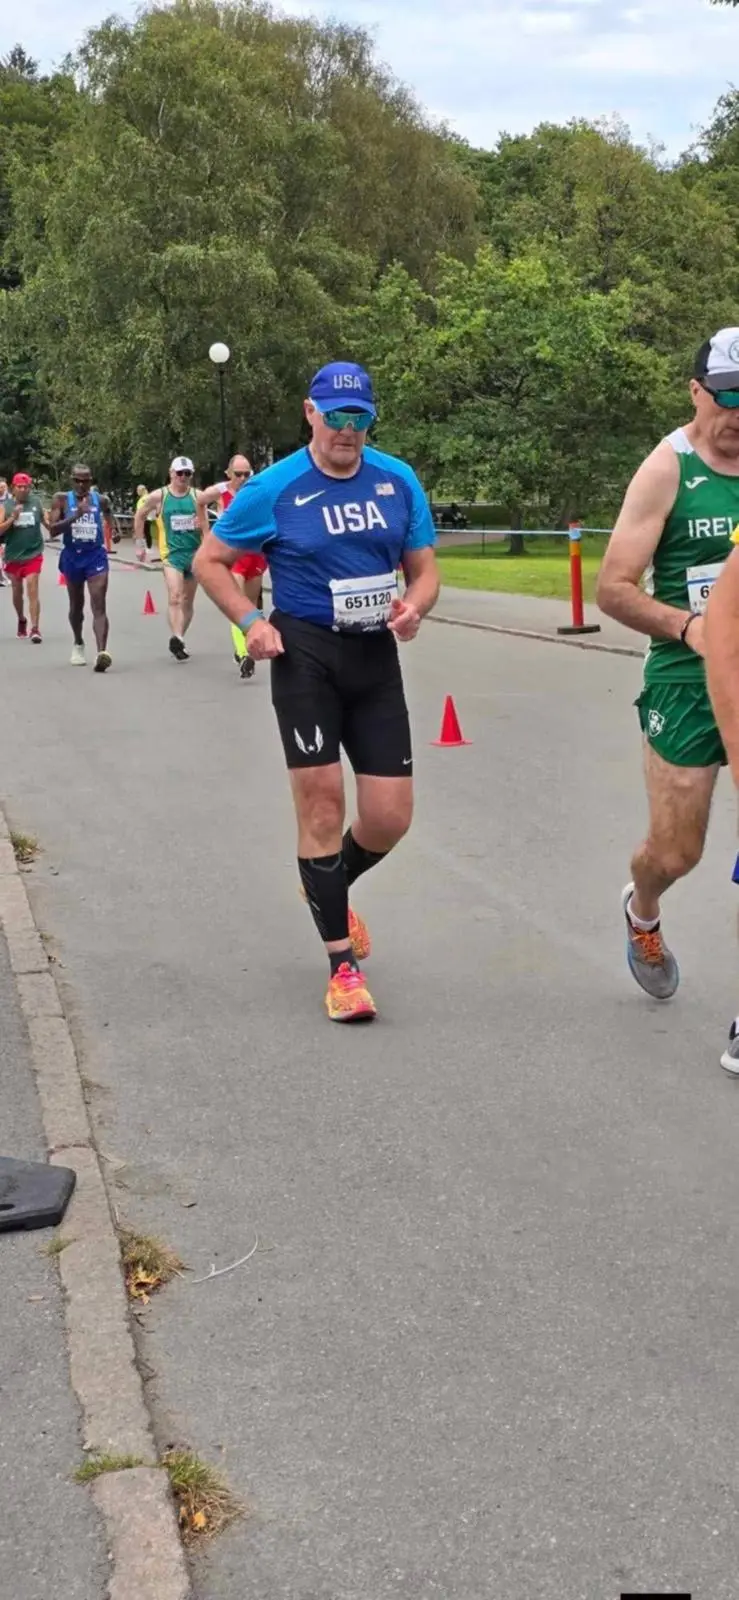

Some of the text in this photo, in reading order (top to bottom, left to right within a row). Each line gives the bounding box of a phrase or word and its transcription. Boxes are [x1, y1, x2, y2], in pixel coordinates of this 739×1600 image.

[333, 374, 362, 390] USA
[322, 501, 388, 535] USA
[345, 592, 391, 610] 651120
